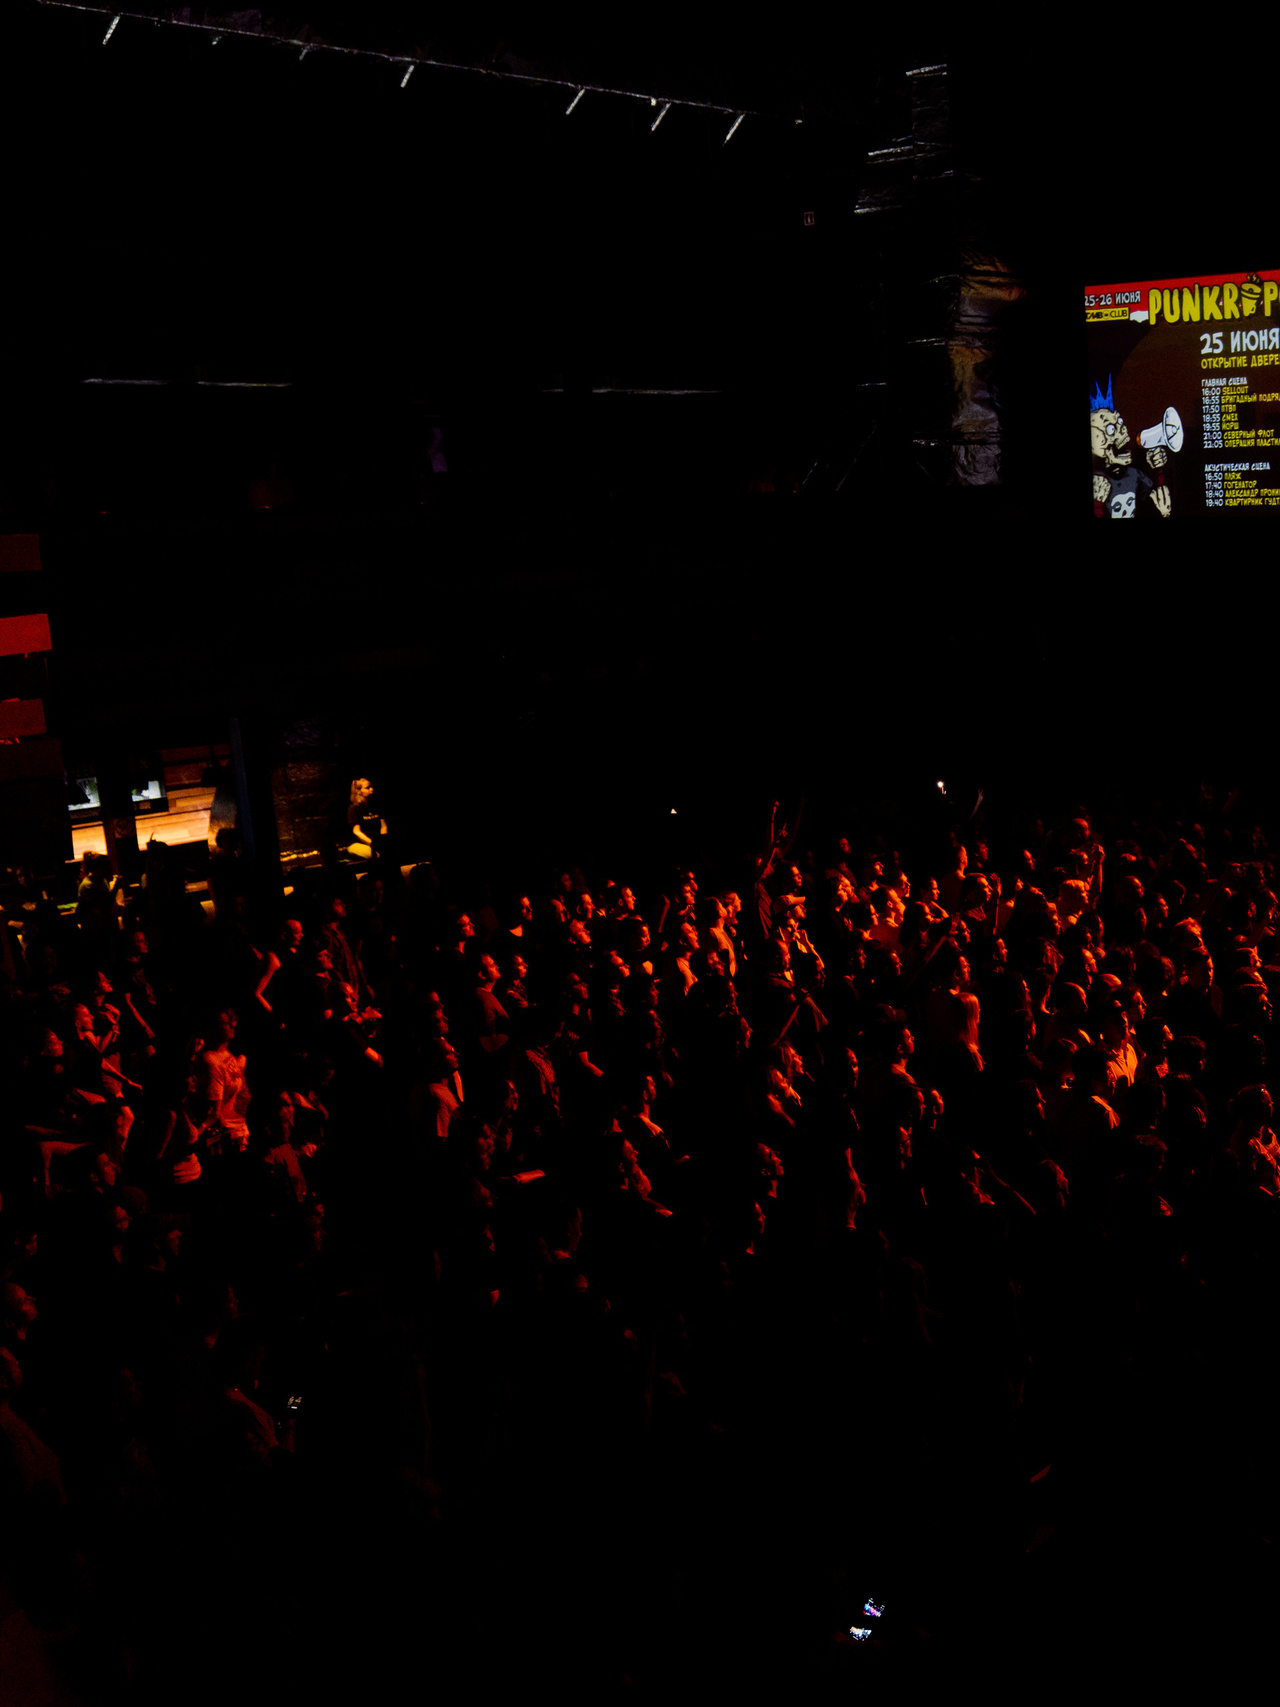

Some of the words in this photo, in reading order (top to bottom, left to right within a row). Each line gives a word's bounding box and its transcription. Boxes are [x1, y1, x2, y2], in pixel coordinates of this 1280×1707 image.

[1115, 291, 1141, 304] ИЮНЯ
[1200, 332, 1223, 354] 25
[1230, 328, 1280, 353] ИЮНЯ
[1201, 355, 1248, 370] ОТКРЫТИЕ
[1201, 378, 1226, 387] ГЛАВНАЯ
[1202, 387, 1220, 396] 16:00
[1222, 386, 1248, 395] SELLOUT
[1202, 396, 1219, 405] 16:55
[1221, 393, 1256, 403] БРИГАДНЫЙ
[1202, 405, 1219, 413] 17:50
[1203, 413, 1220, 422] 18:55
[1203, 422, 1220, 431] 19:55
[1203, 431, 1221, 440] 21:00
[1223, 429, 1255, 439] СЕВЕРНЫЙ
[1203, 440, 1223, 449] 22:05
[1205, 472, 1223, 481] 16:50
[1205, 481, 1222, 489] 17:40
[1205, 489, 1223, 498] 18:40
[1225, 488, 1258, 497] АЛЕКСАНДР
[1205, 498, 1223, 507] 19:40
